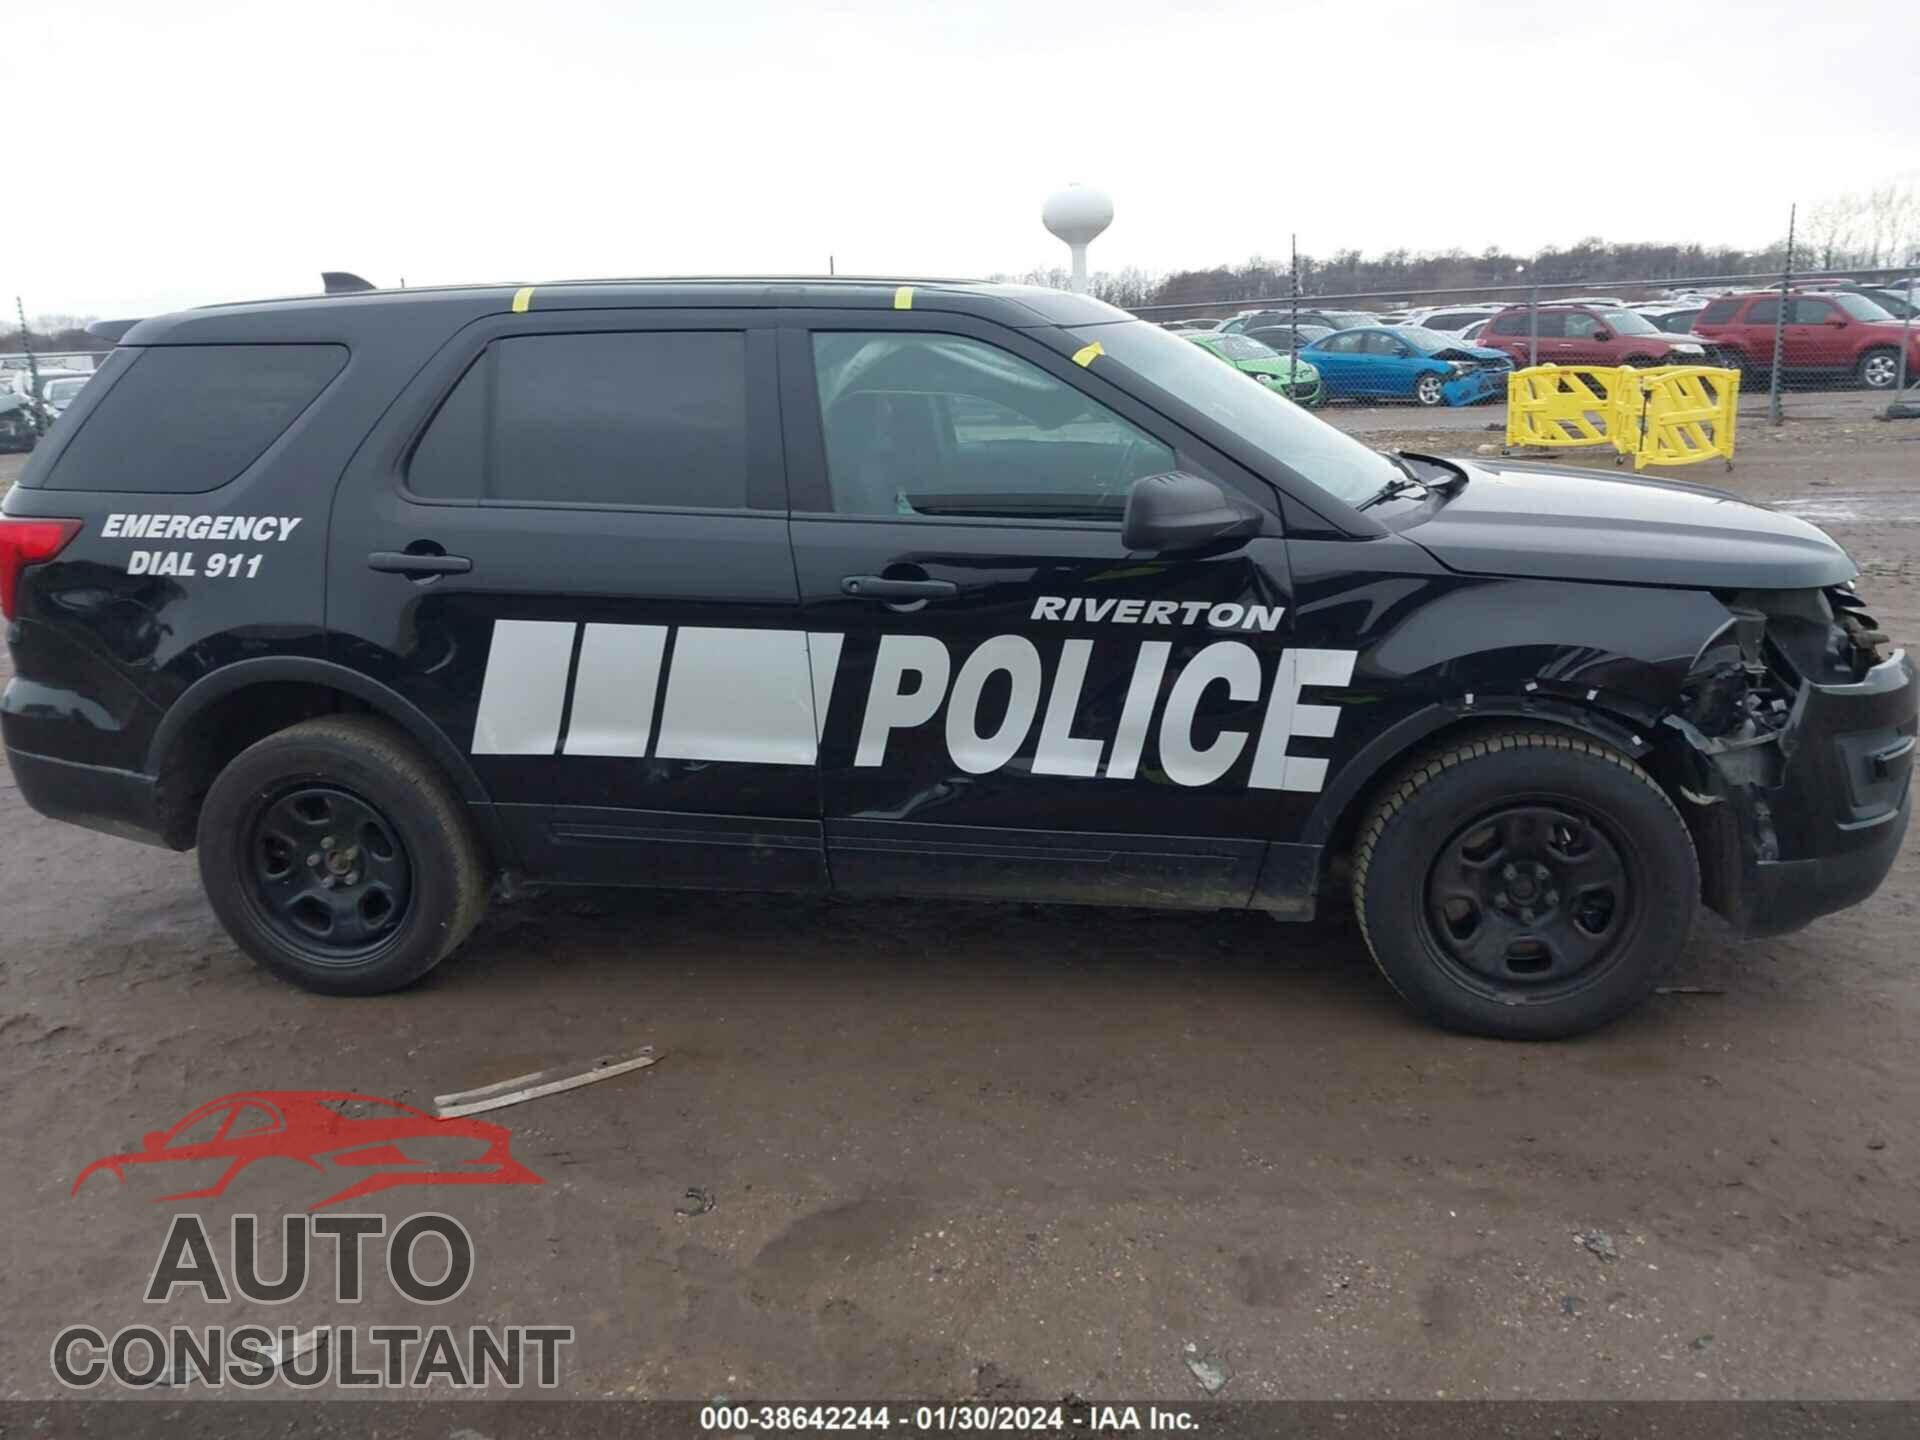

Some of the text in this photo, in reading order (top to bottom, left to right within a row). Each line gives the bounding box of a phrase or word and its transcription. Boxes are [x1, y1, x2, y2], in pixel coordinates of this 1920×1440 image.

[100, 513, 303, 542] EMERGENCY
[127, 550, 264, 579] DIAL 911
[1030, 595, 1286, 632] RIVERTON
[854, 634, 1358, 793] POLICE
